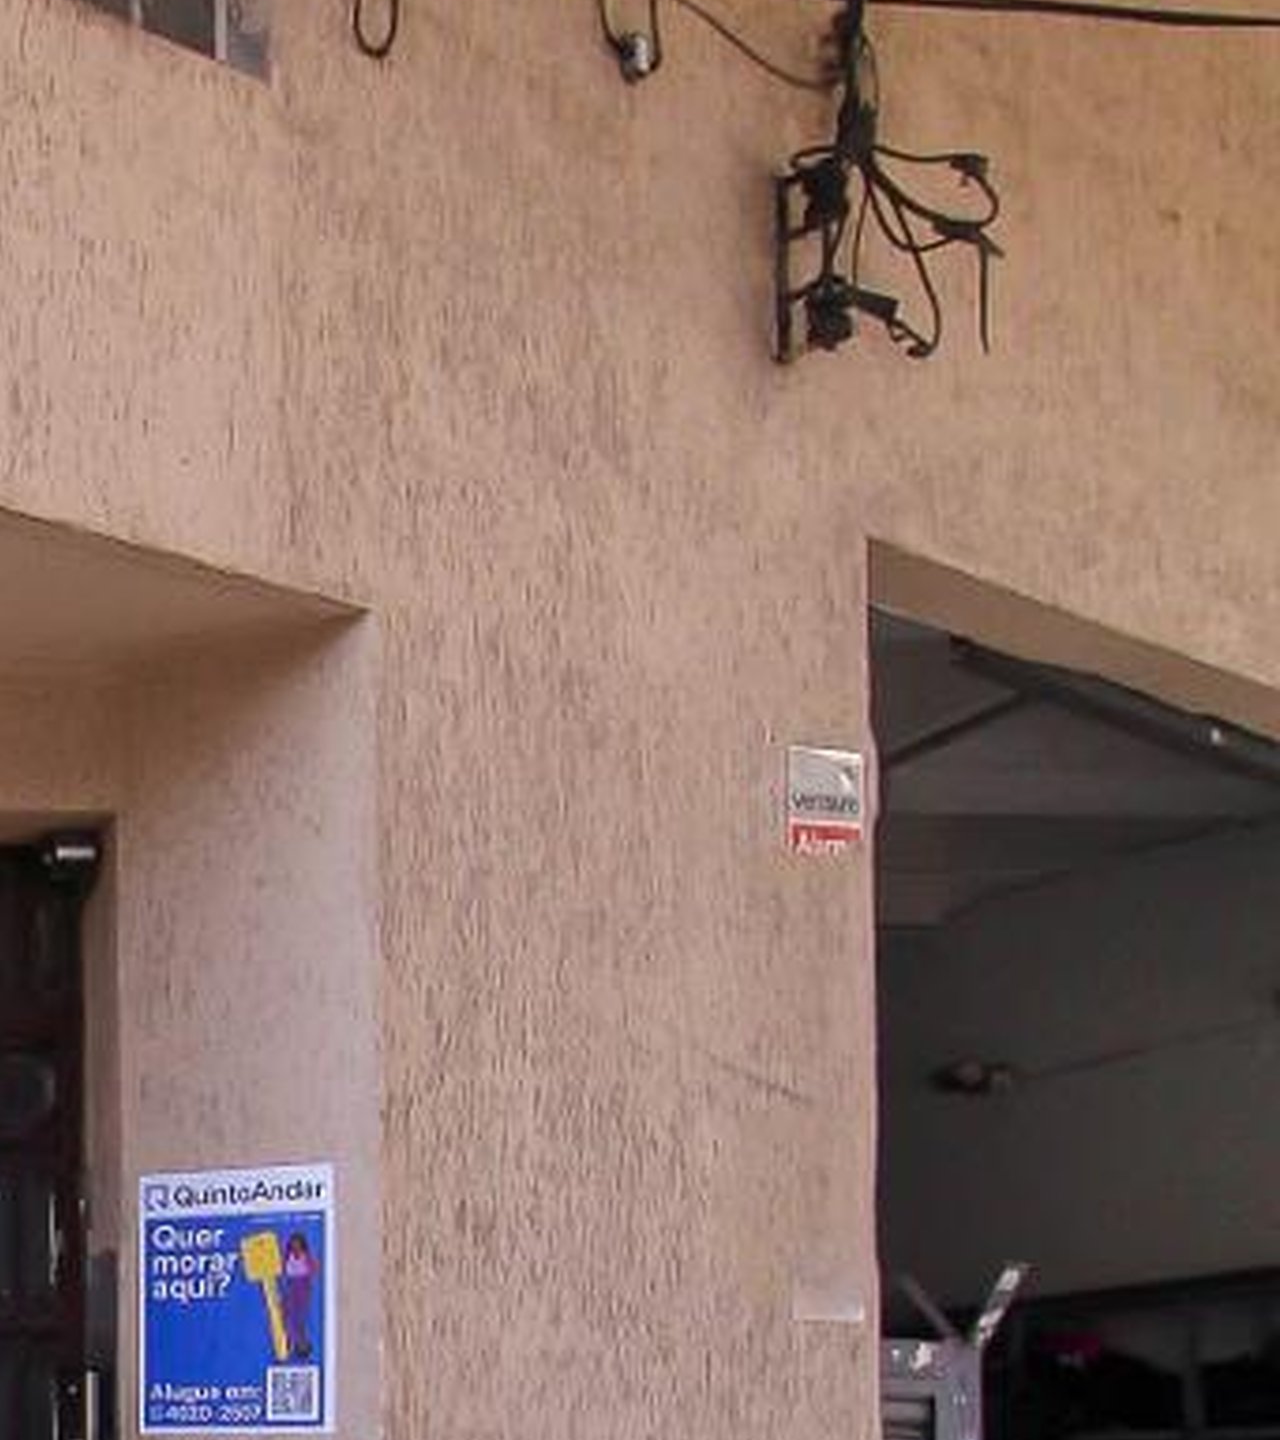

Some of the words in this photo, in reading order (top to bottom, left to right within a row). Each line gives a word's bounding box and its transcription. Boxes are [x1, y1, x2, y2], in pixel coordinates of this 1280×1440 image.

[173, 1180, 323, 1208] QuintoAndar
[152, 1224, 224, 1251] Quer
[153, 1251, 238, 1276] morar
[153, 1274, 231, 1306] aqui?
